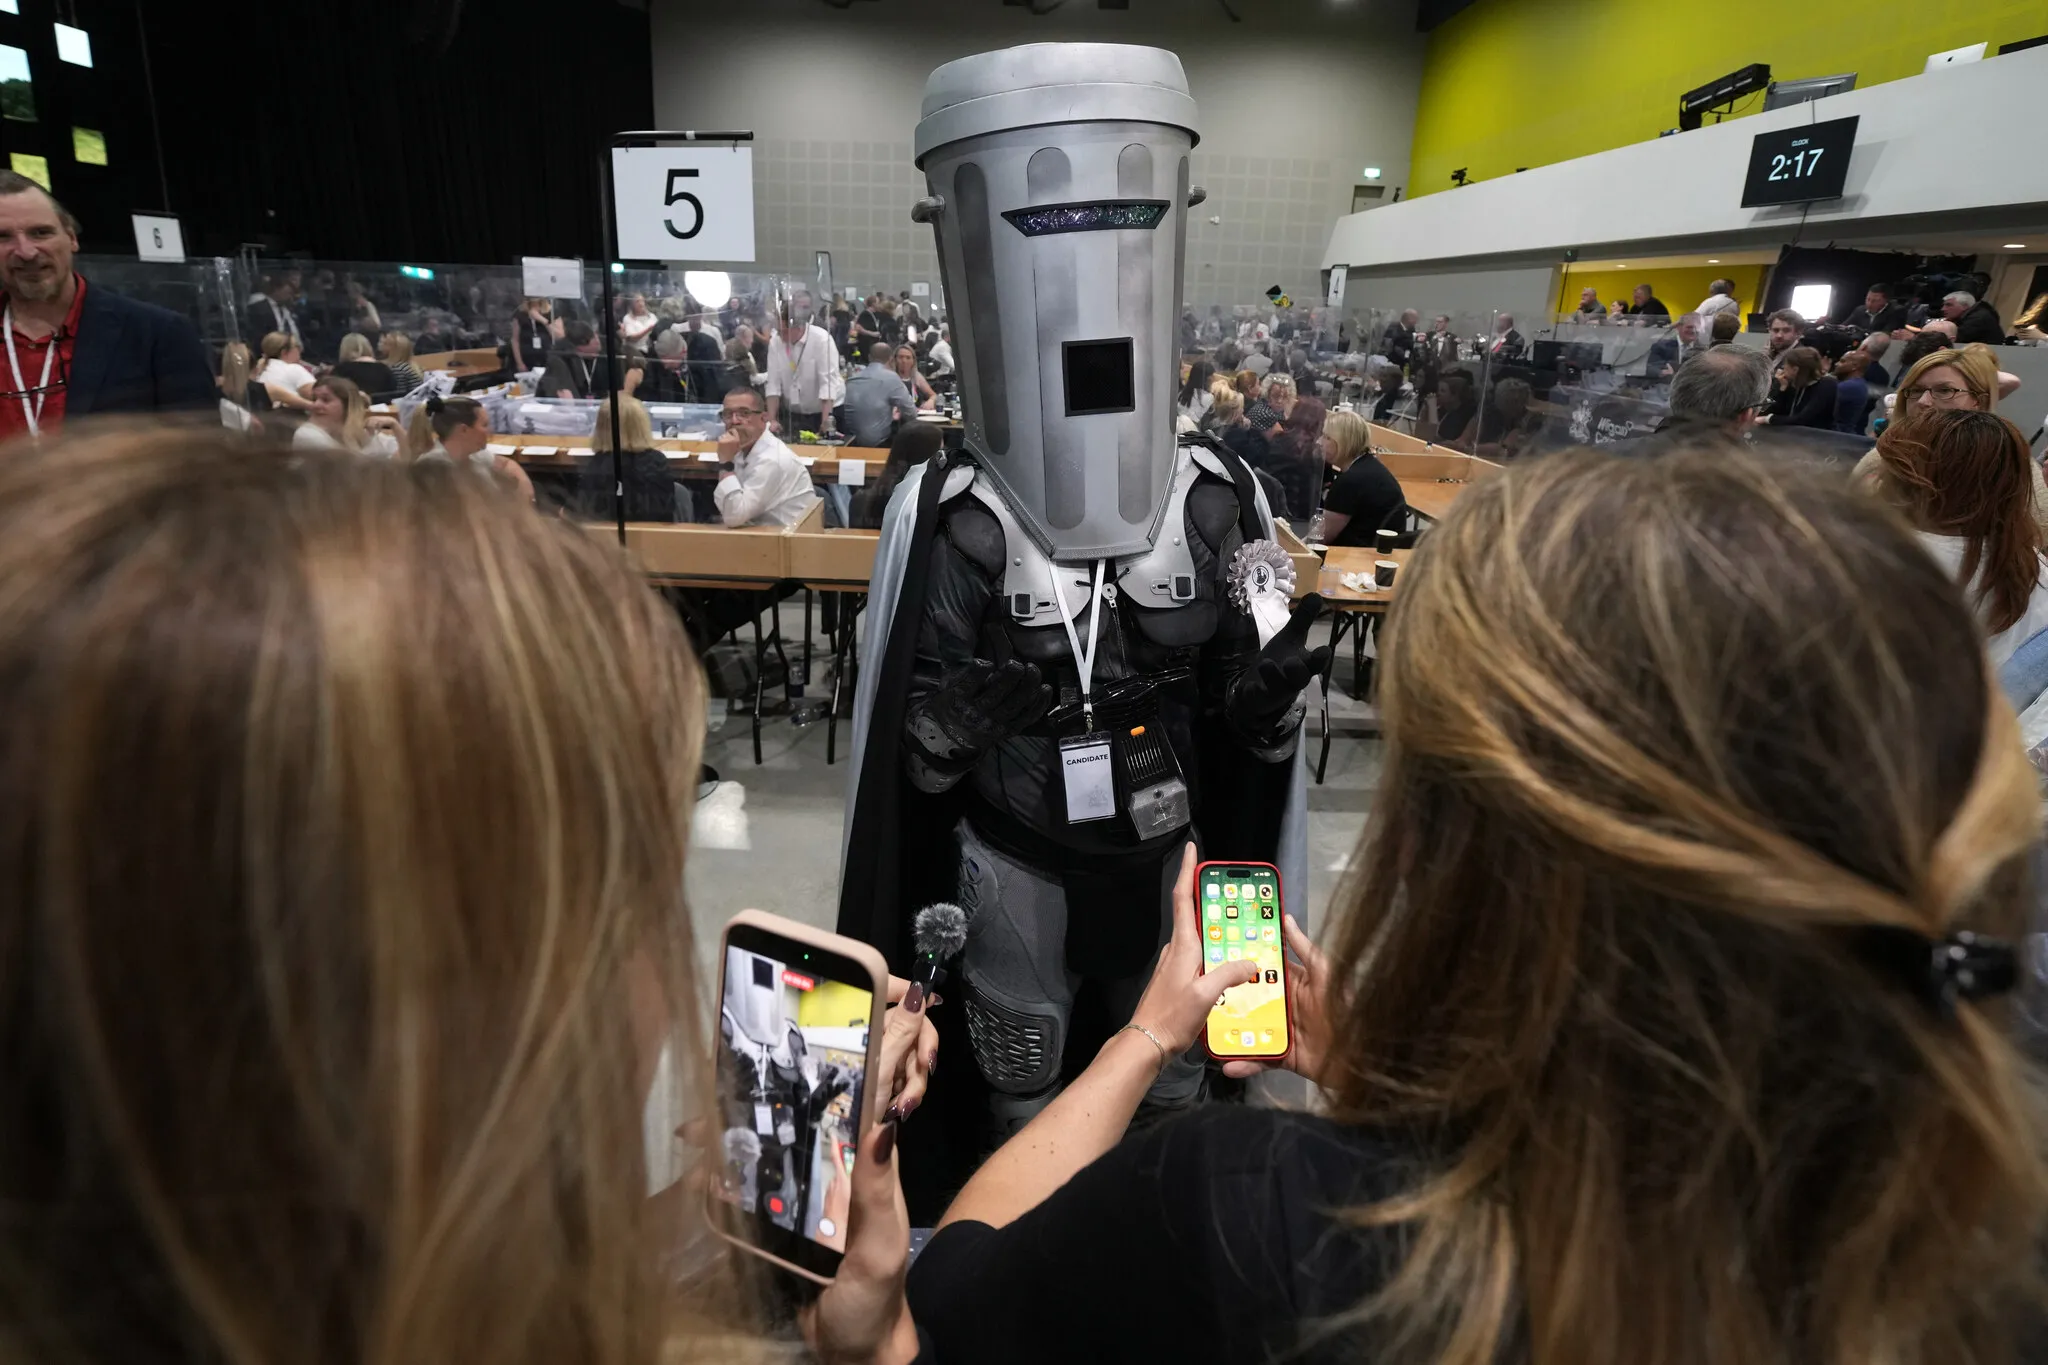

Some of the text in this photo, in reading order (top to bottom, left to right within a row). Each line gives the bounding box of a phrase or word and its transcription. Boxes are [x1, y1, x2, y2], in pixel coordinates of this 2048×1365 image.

[1768, 148, 1825, 181] 2:17
[663, 168, 704, 240] 5
[153, 227, 163, 249] 6
[1066, 753, 1109, 766] CANDIDATE
